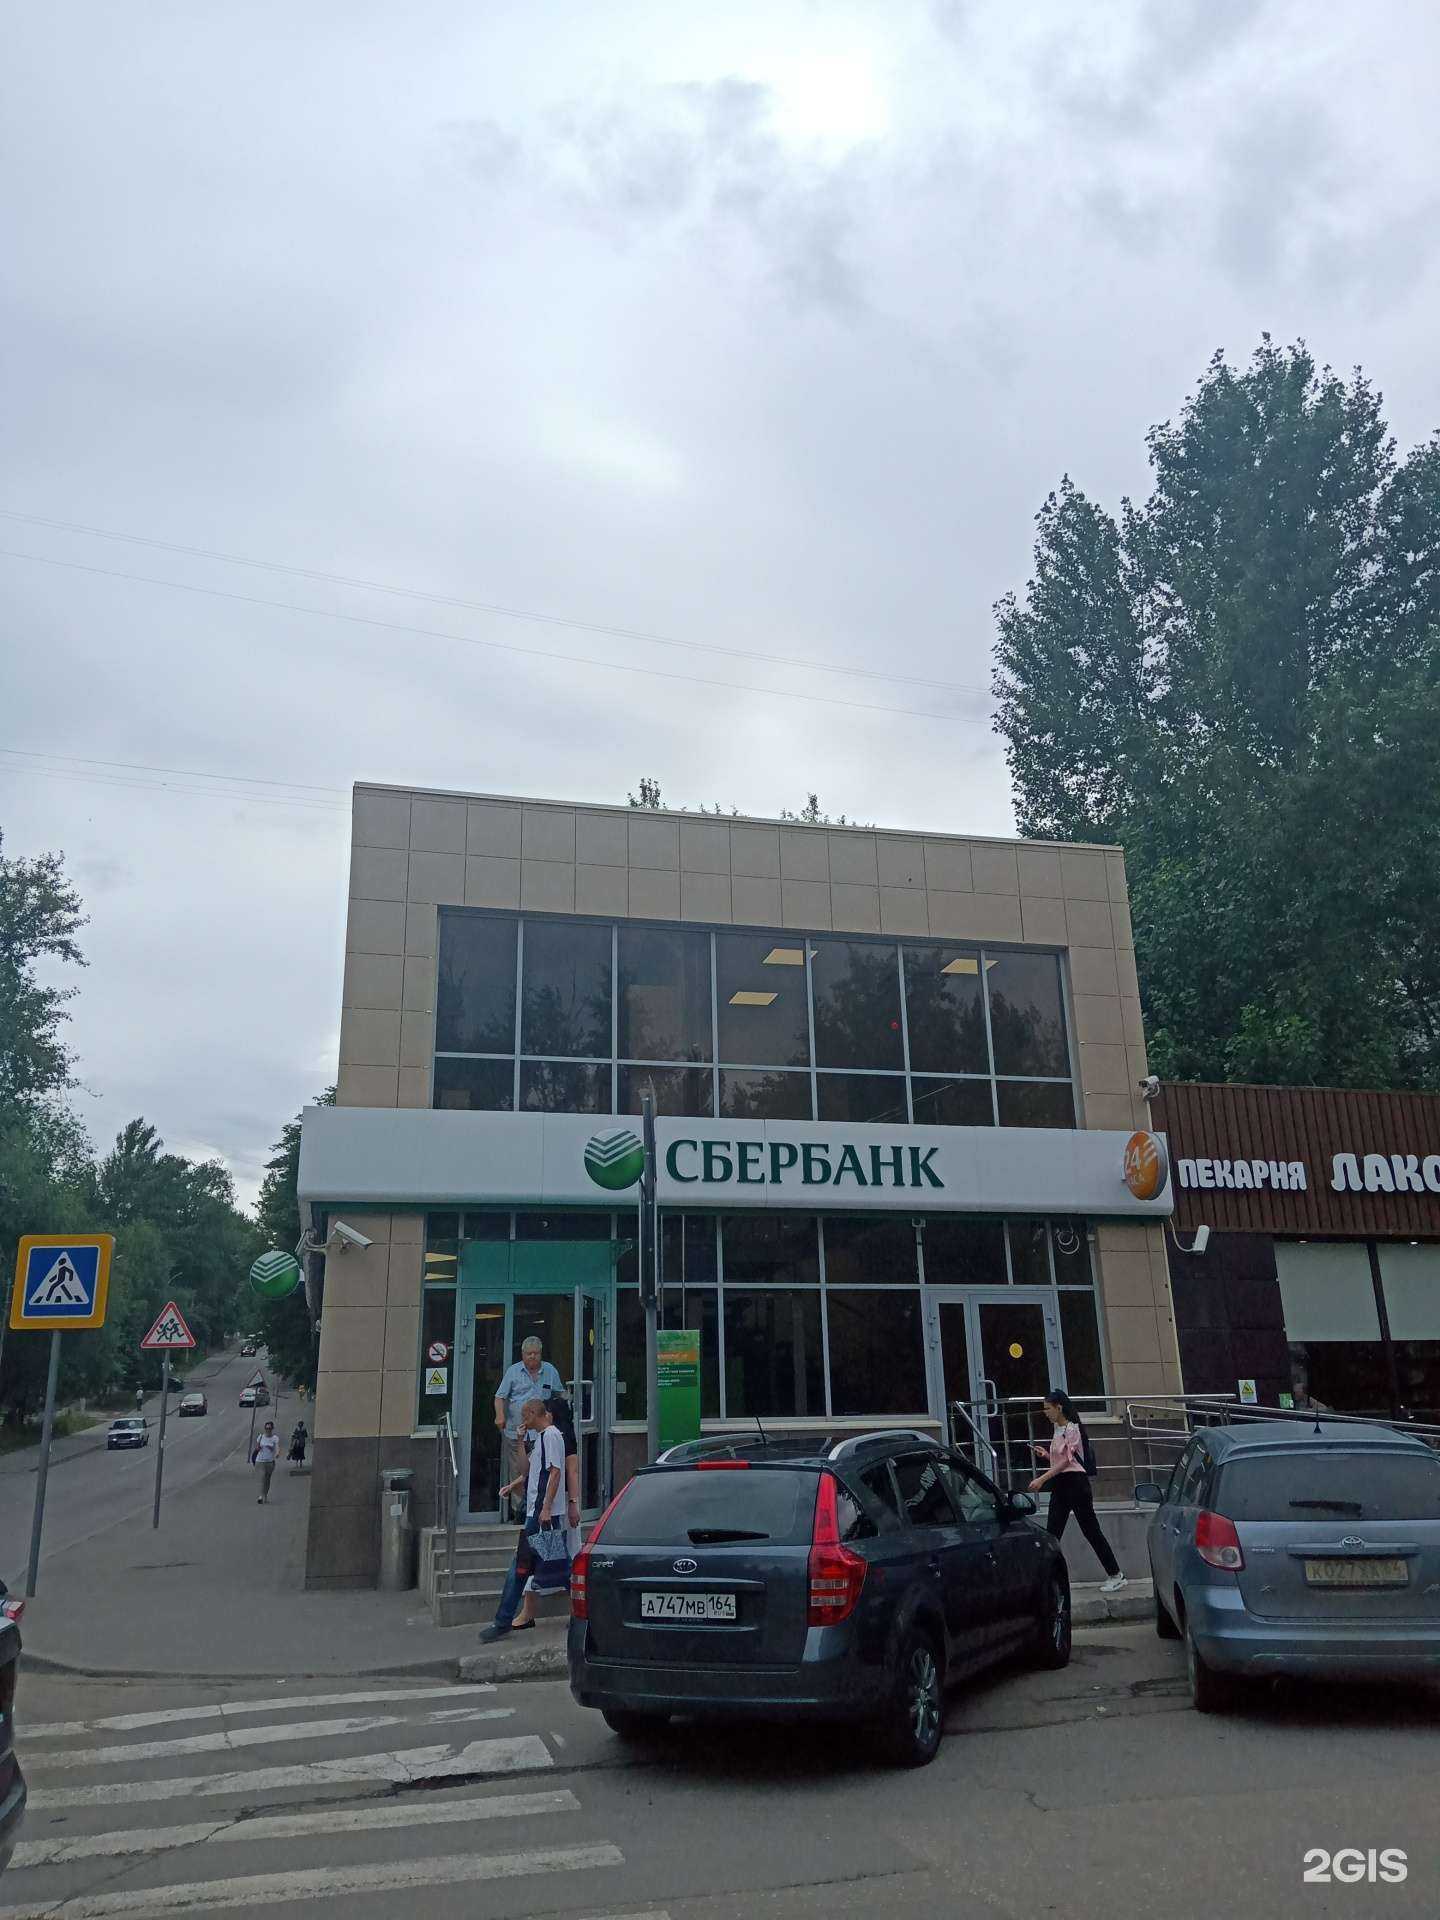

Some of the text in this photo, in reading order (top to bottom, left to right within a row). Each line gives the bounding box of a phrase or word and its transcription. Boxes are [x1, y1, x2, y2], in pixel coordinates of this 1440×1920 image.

[664, 1138, 946, 1189] СБЕРБАНК
[1178, 1159, 1307, 1190] ПЕКАРНЯ
[709, 1596, 732, 1611] 164
